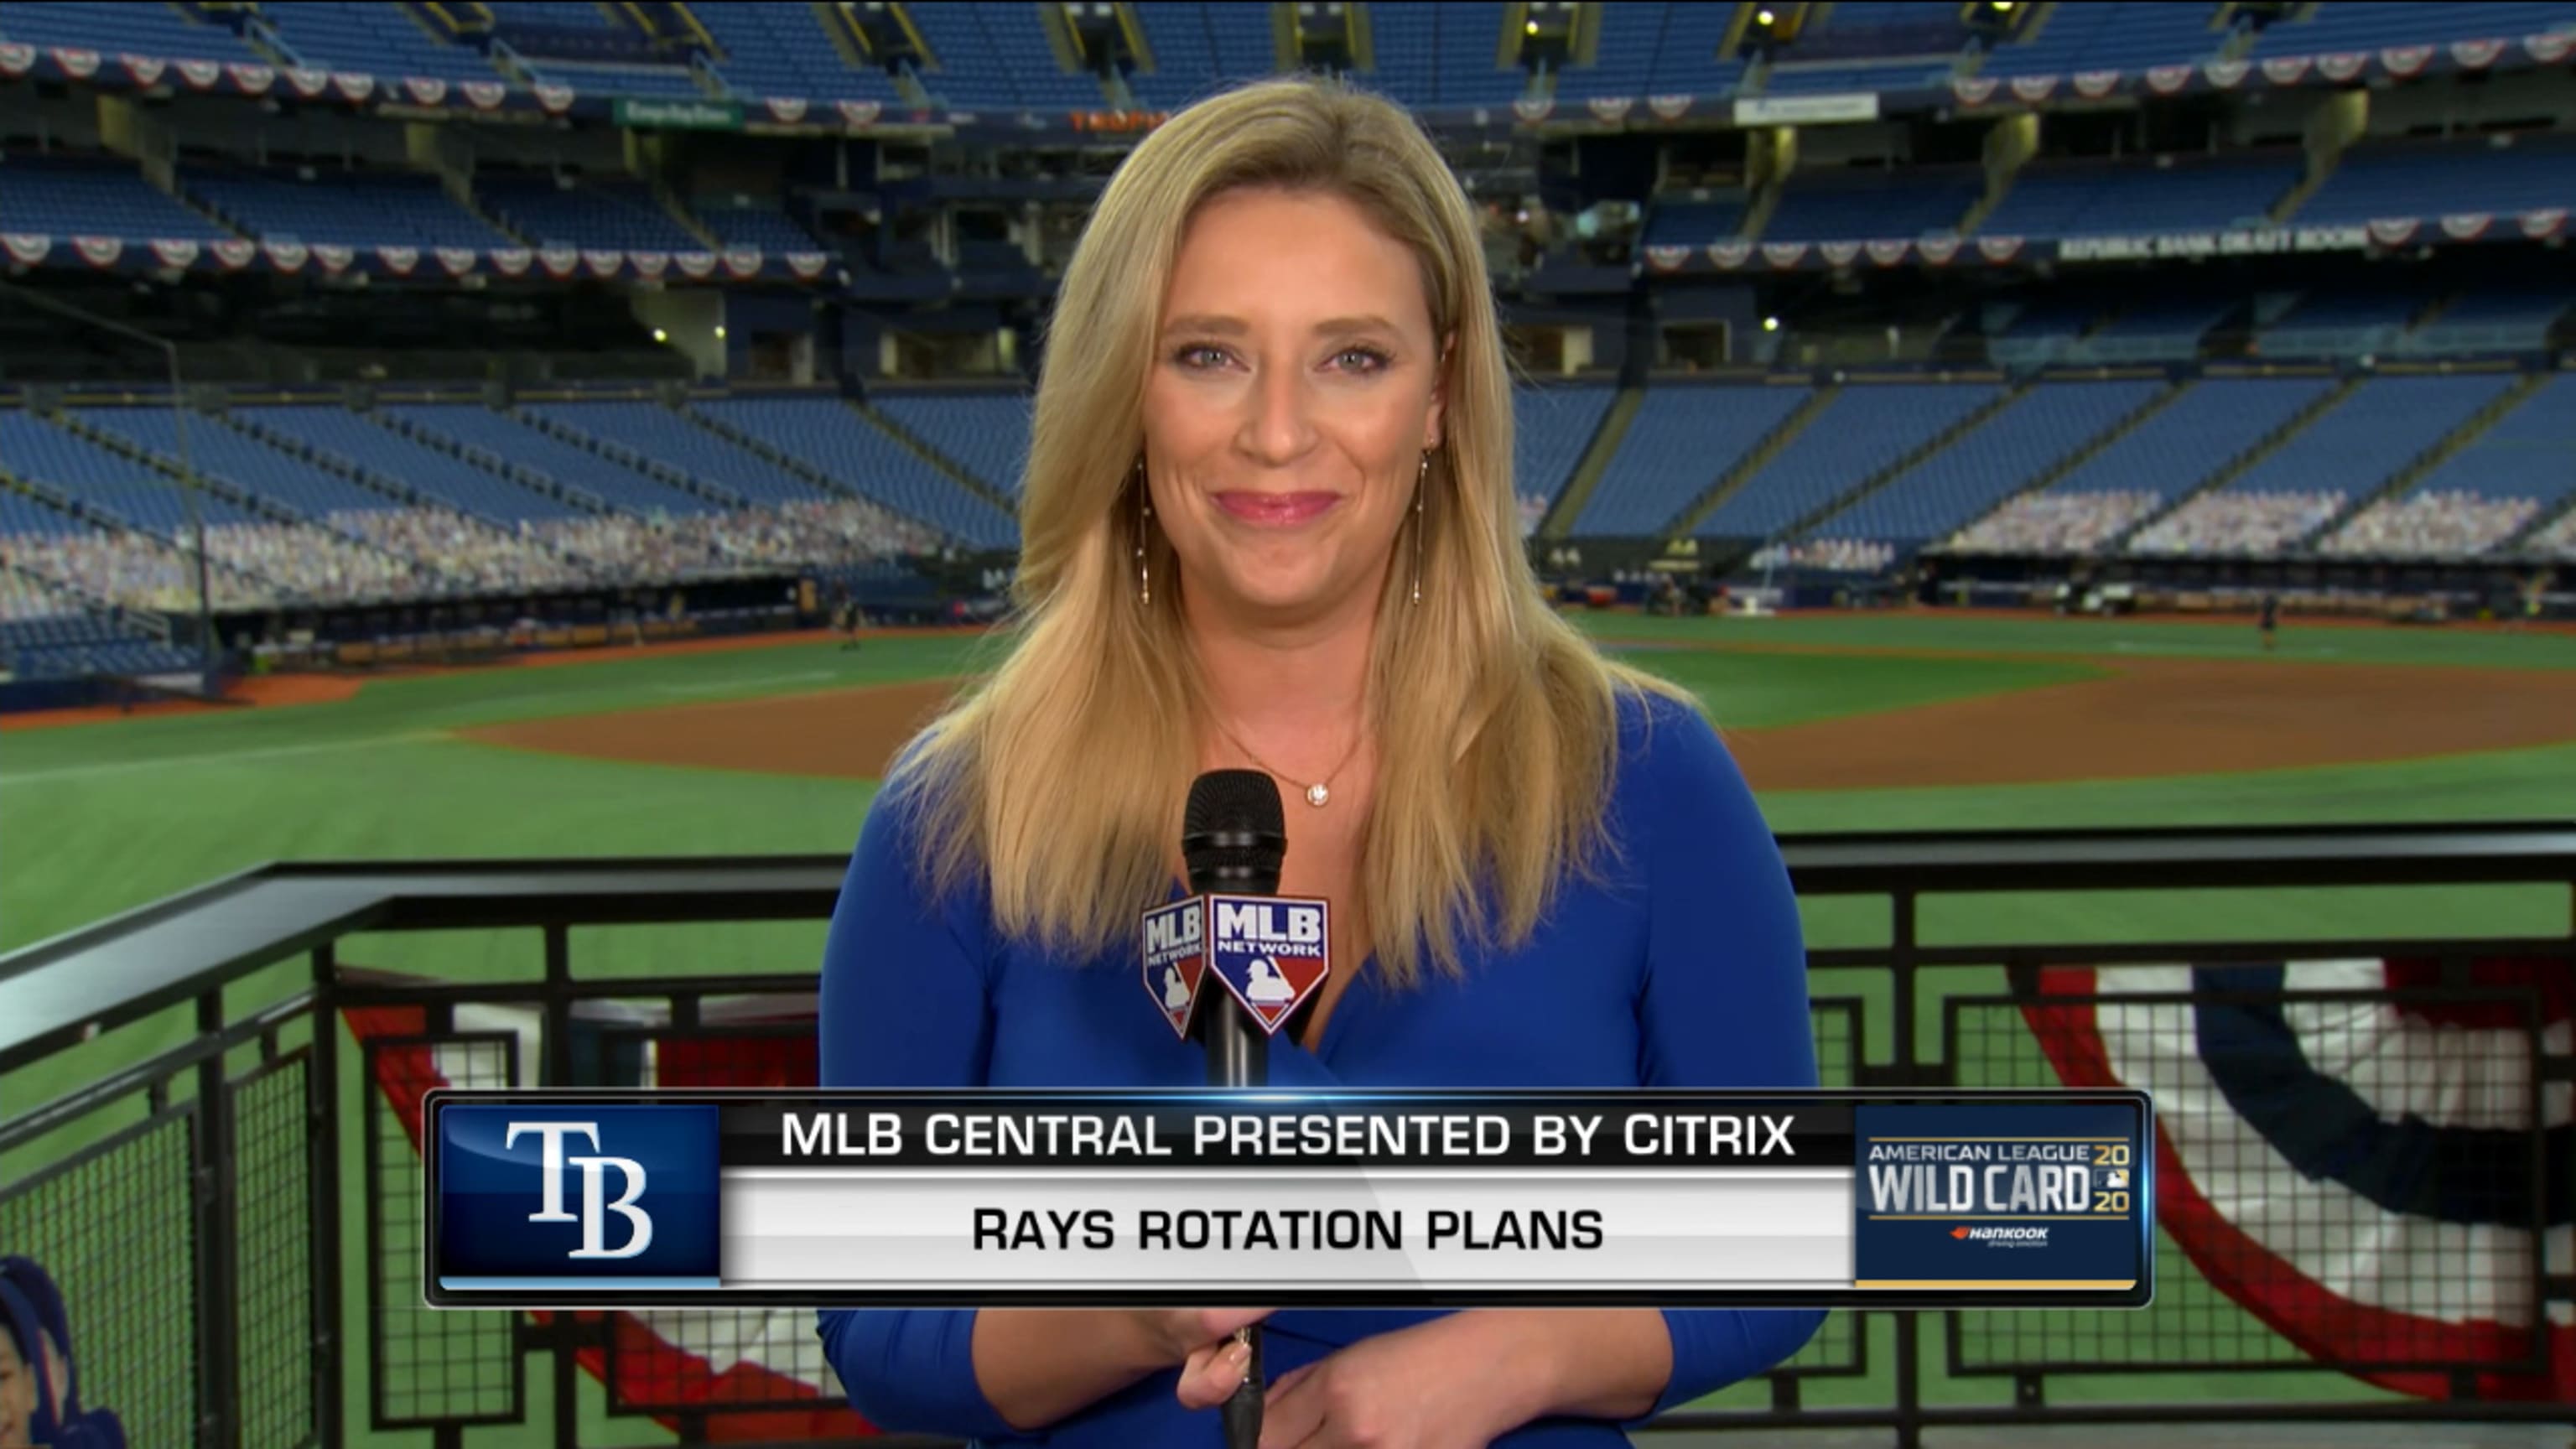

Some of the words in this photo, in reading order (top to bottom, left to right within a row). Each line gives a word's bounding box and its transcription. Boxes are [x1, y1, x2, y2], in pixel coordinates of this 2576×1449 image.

[2158, 234, 2215, 256] BANK
[1146, 905, 1201, 954] MLB
[1218, 903, 1322, 943] MLB
[1147, 943, 1202, 966] NETWORK
[1218, 939, 1322, 957] NETWORK
